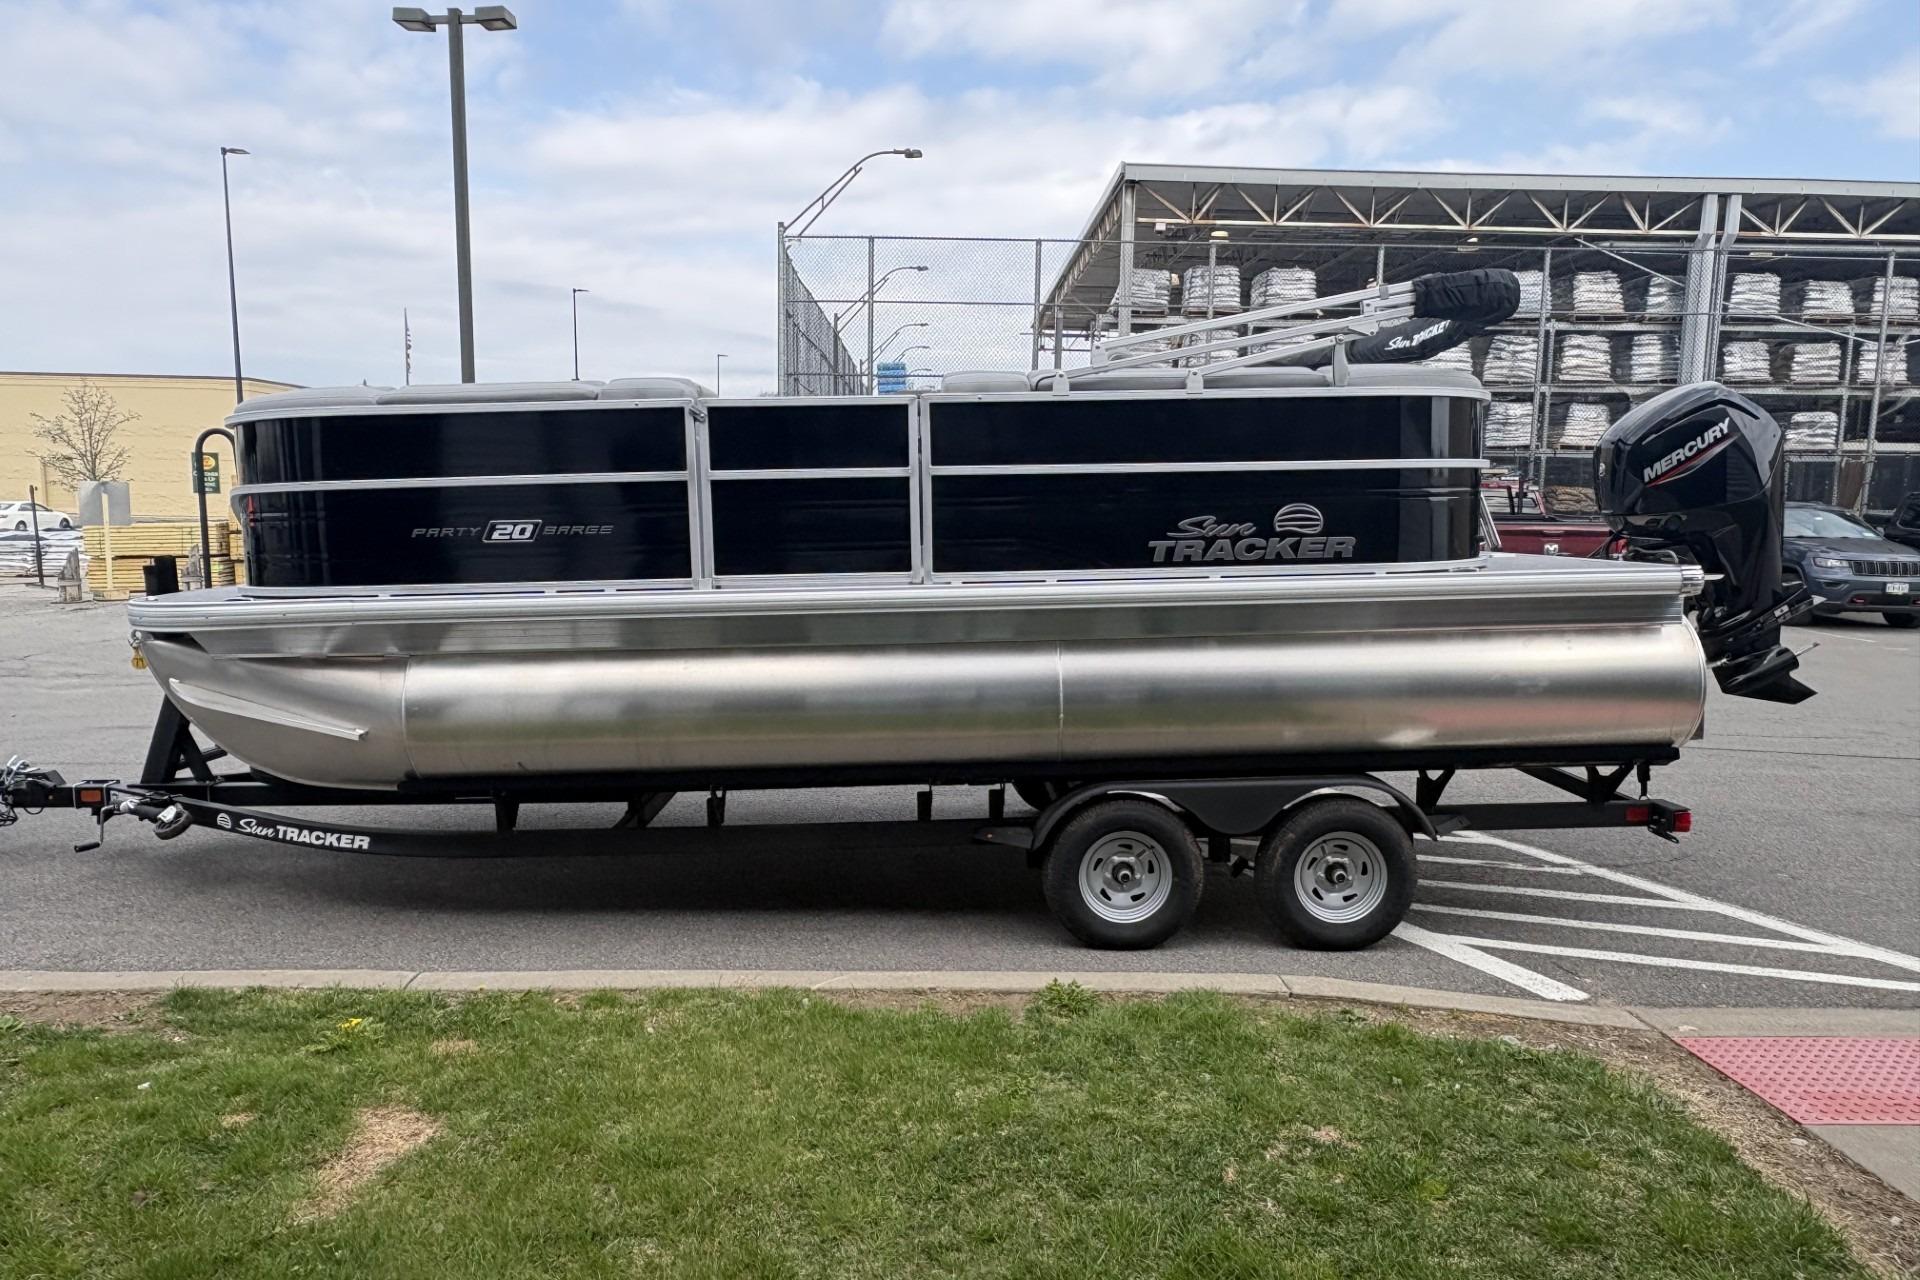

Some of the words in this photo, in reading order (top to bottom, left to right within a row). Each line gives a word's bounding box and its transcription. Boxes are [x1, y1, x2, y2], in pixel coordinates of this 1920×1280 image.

[1643, 417, 1730, 483] MERCURY
[411, 527, 481, 538] PARTY
[491, 524, 534, 540] 20
[542, 525, 614, 535] BARGE
[1166, 515, 1256, 538] Sun
[1148, 536, 1356, 562] TRACKER
[235, 818, 276, 838] Sun
[276, 825, 370, 850] TRACKER
